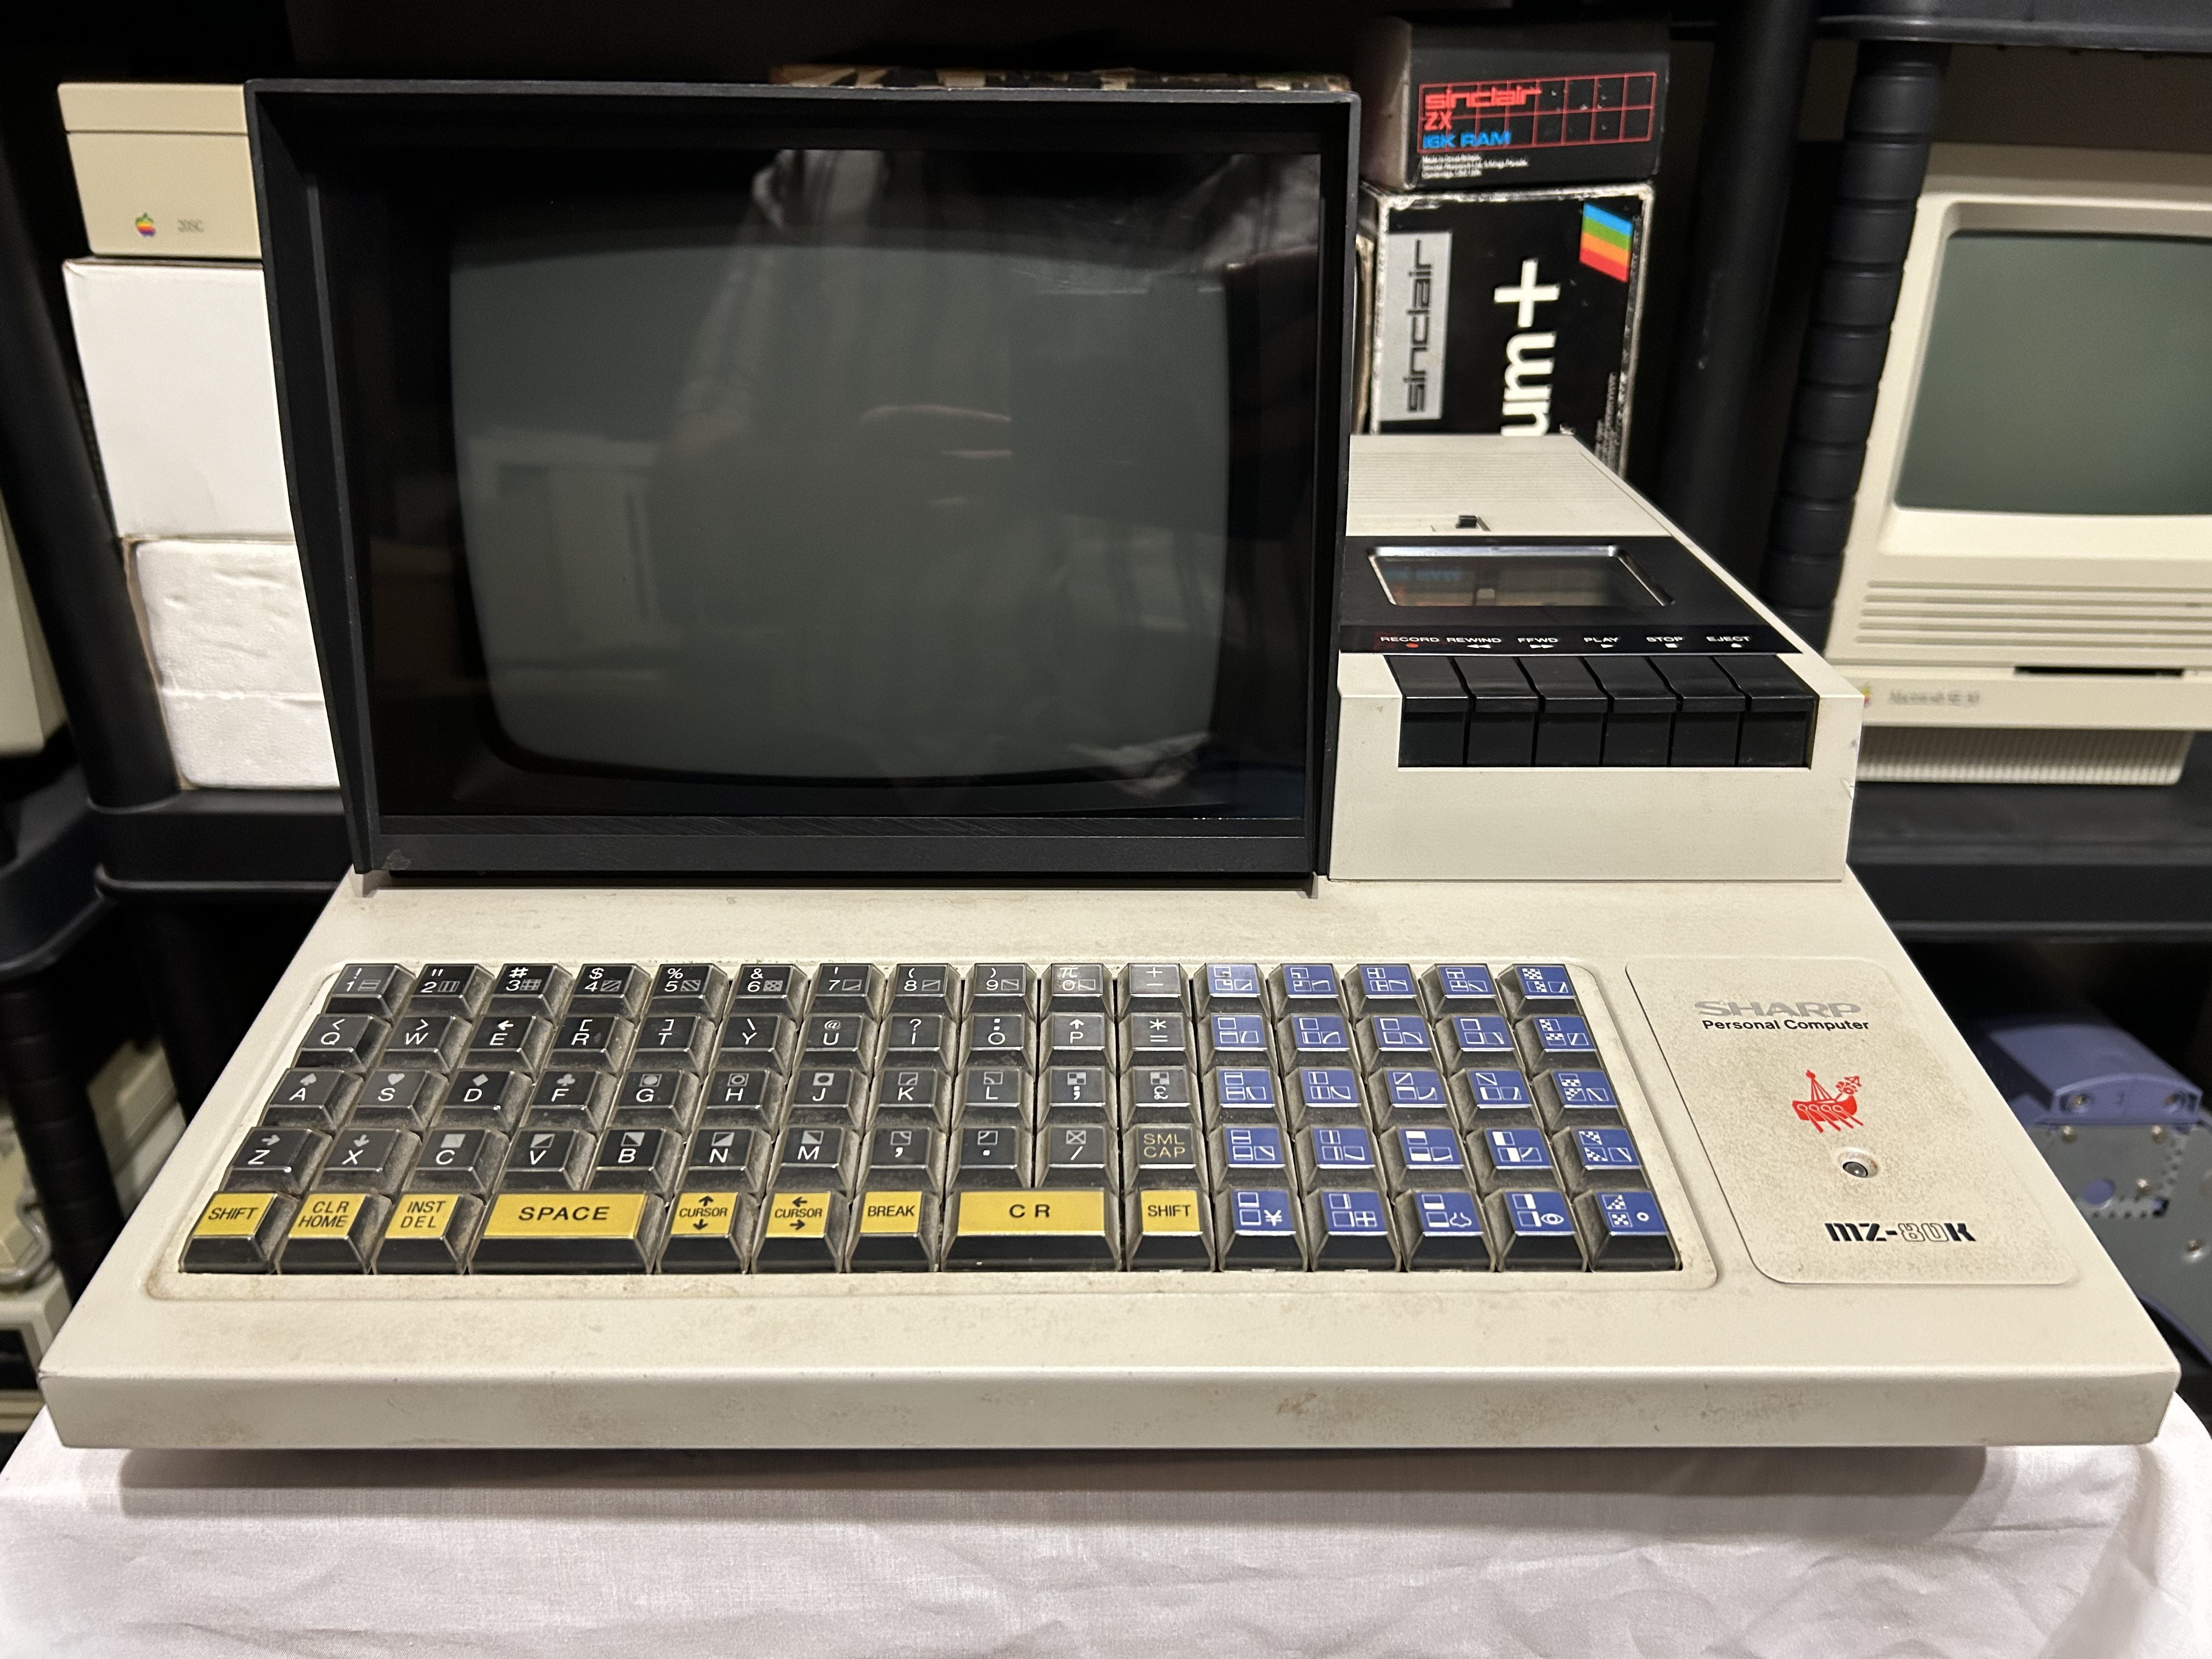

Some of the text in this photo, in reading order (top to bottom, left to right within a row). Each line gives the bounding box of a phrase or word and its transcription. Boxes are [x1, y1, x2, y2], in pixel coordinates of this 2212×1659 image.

[1425, 86, 1542, 109] sinclair
[1424, 111, 1453, 131] ZX
[1460, 131, 1511, 147] RAM
[1403, 239, 1433, 413] sinclair
[353, 968, 362, 979] !
[509, 967, 529, 978] #
[589, 967, 605, 980] $
[667, 968, 684, 979] %
[751, 968, 764, 979] &
[907, 967, 916, 979] (
[990, 967, 997, 979] )
[1146, 966, 1164, 978] +
[346, 980, 353, 992] 1
[421, 981, 437, 993] 2
[505, 979, 520, 992] 3
[584, 981, 598, 992] 4
[664, 980, 679, 992] 5
[747, 980, 761, 992] 6
[829, 979, 841, 991] 7
[904, 980, 917, 991] 8
[986, 979, 999, 991] 9
[1062, 979, 1076, 991] 0
[1694, 1001, 1861, 1018] SHARP
[332, 1018, 345, 1030] <
[416, 1019, 428, 1031] >
[824, 1020, 841, 1030] @
[910, 1018, 922, 1031] ?
[994, 1018, 1001, 1031] :
[1701, 1019, 1869, 1032] Personal Computer
[320, 1031, 340, 1045] Q
[405, 1032, 428, 1045] W
[489, 1033, 508, 1046] E
[571, 1032, 590, 1046] R
[658, 1032, 673, 1045] T
[742, 1032, 757, 1045] Y
[823, 1032, 839, 1046] U
[988, 1032, 1006, 1045] O
[1070, 1031, 1084, 1043] P
[289, 1087, 306, 1101] A
[377, 1087, 396, 1102] S
[464, 1088, 482, 1102] D
[551, 1088, 569, 1102] F
[636, 1088, 654, 1103] G
[725, 1088, 744, 1102] H
[812, 1087, 826, 1102] J
[898, 1087, 914, 1101] K
[985, 1086, 998, 1100] L
[1073, 1086, 1080, 1101] ;
[1154, 1086, 1169, 1100] £
[1143, 1133, 1185, 1144] SML
[247, 1149, 271, 1165] Z
[342, 1149, 364, 1165] X
[436, 1149, 455, 1165] C
[530, 1150, 547, 1165] V
[618, 1148, 636, 1163] B
[709, 1148, 729, 1163] N
[797, 1146, 820, 1160] M
[1070, 1146, 1083, 1160] /
[1143, 1147, 1186, 1158] CAP
[312, 1200, 350, 1214] CLR
[406, 1200, 446, 1214] INST
[518, 1206, 610, 1221] SPACE
[679, 1207, 729, 1218] CURSOR
[774, 1207, 823, 1218] CURSOR
[867, 1205, 916, 1217] BREAK
[1147, 1205, 1192, 1217] SHIFT
[208, 1207, 258, 1221] SHIFT
[1263, 1209, 1283, 1227] ¥
[298, 1215, 348, 1228] HOME
[400, 1216, 437, 1228] DEL
